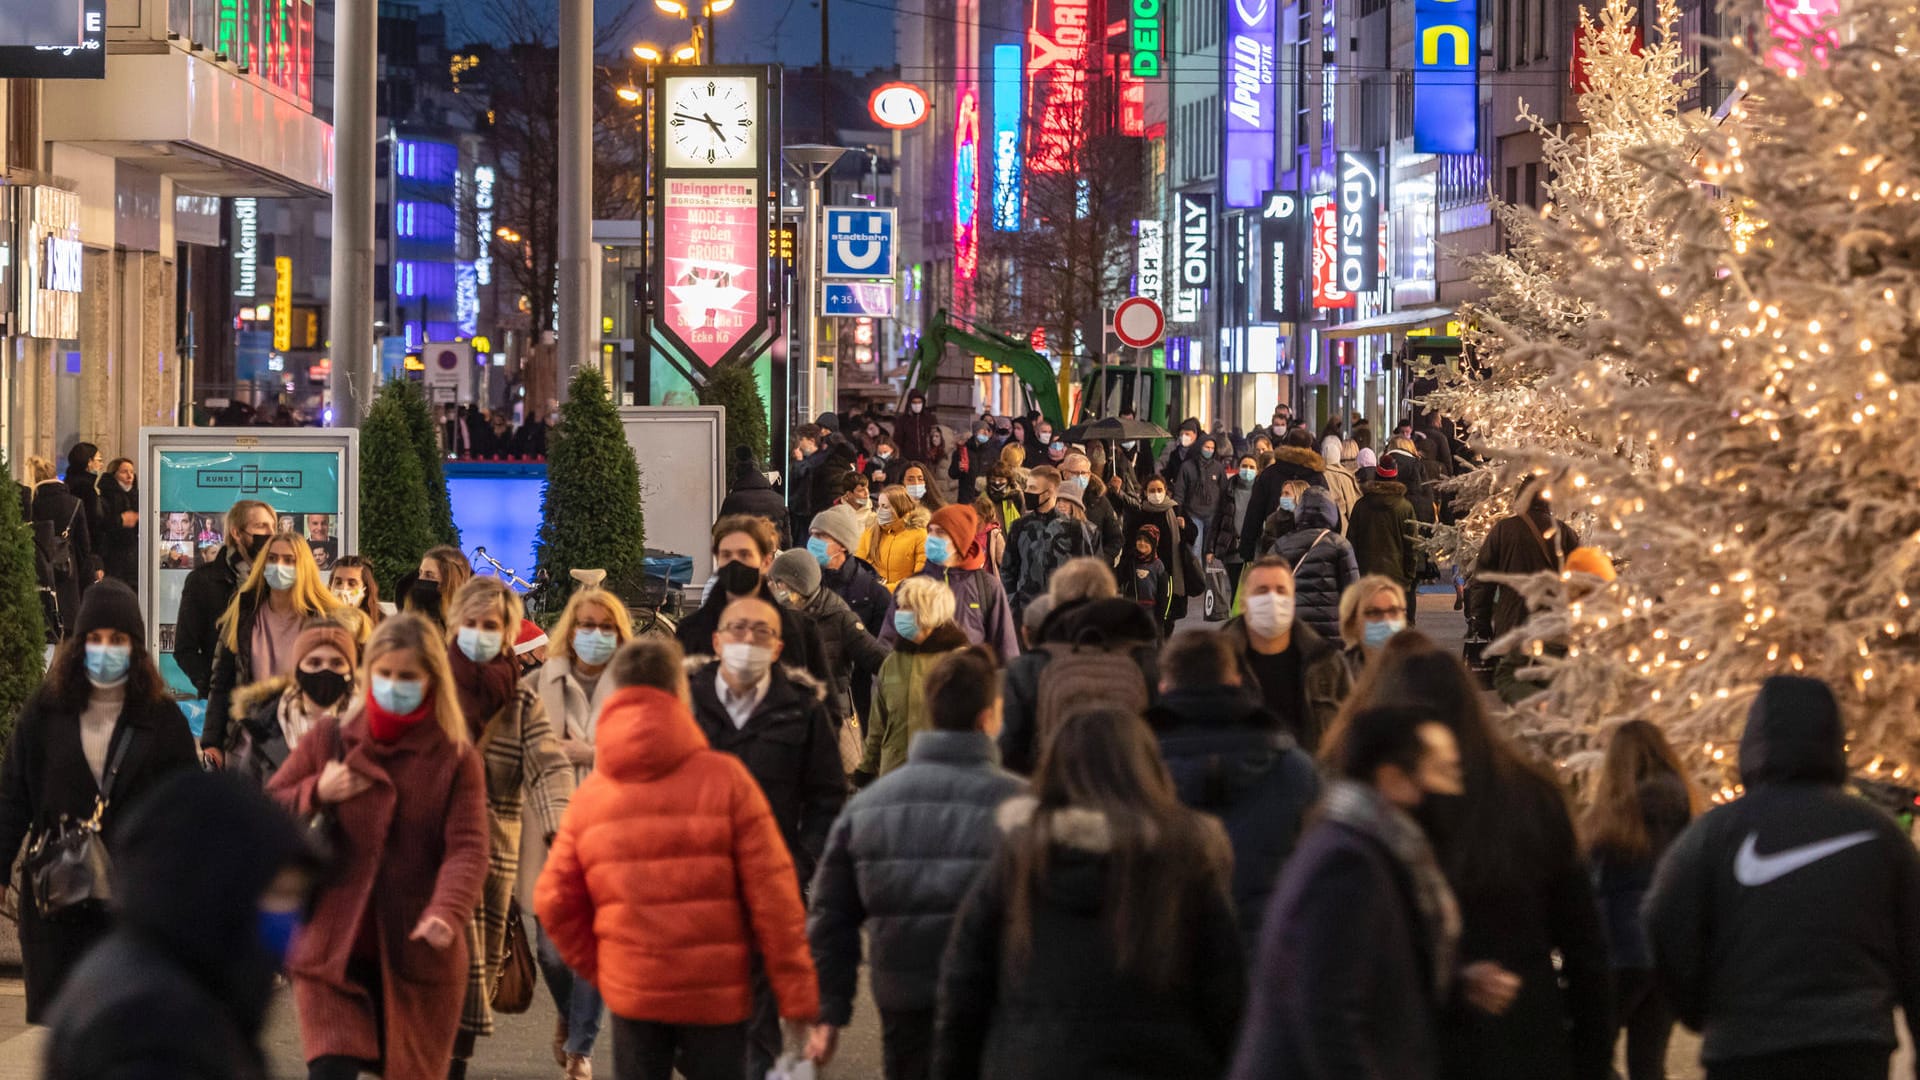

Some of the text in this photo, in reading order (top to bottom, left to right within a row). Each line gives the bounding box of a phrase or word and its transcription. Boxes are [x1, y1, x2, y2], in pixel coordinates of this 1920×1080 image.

[1027, 0, 1088, 76] YOR
[1261, 45, 1273, 84] OPTIK
[1230, 34, 1261, 129] APOLLO
[671, 183, 745, 198] Weingarten
[1263, 195, 1295, 218] JD
[687, 209, 723, 225] MODE
[1342, 152, 1377, 291] orsay
[690, 225, 732, 243] großen
[831, 234, 888, 242] stadtbahn
[1184, 198, 1207, 284] ONLY
[1143, 258, 1158, 300] USH
[840, 295, 853, 304] 35
[691, 331, 713, 343] Ecke
[205, 475, 234, 483] KUNST
